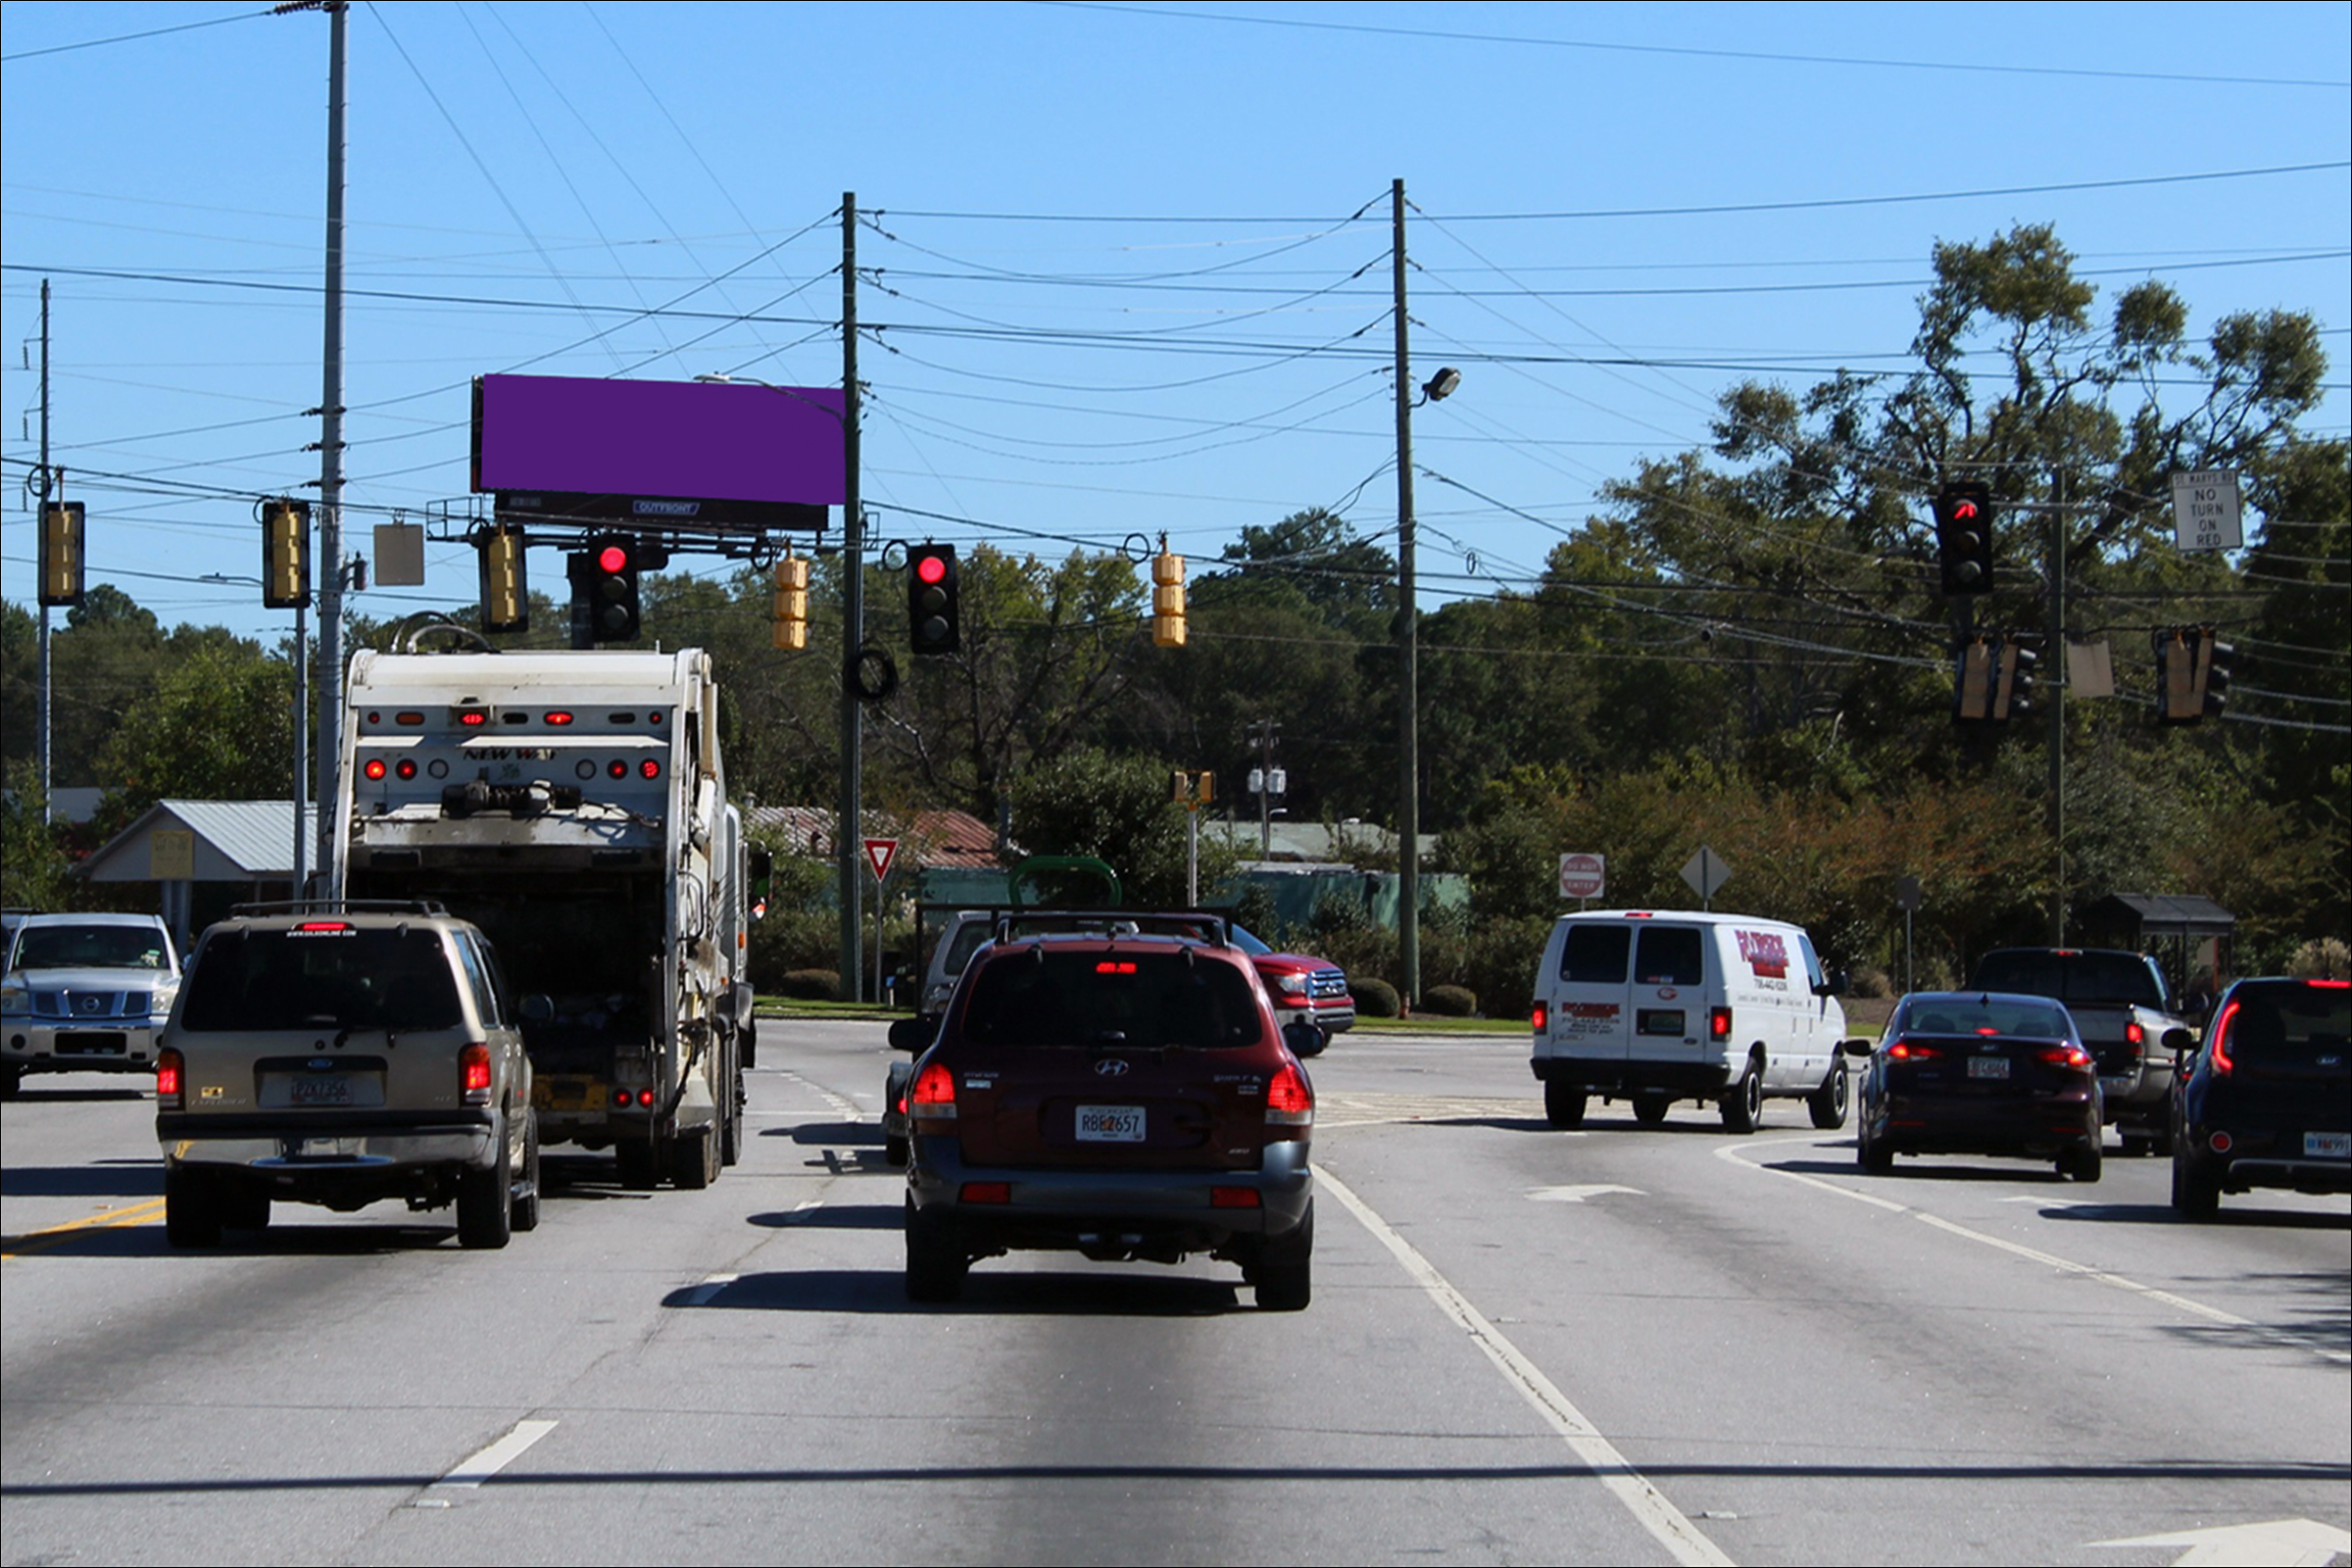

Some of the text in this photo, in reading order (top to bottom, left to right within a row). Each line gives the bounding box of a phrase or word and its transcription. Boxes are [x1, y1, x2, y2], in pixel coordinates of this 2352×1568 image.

[2195, 488, 2217, 502] NO
[638, 501, 692, 514] OUTFRONT
[2190, 503, 2224, 516] TURN
[2198, 518, 2217, 531] ON
[2196, 533, 2222, 547] RED
[463, 747, 511, 760] NEW
